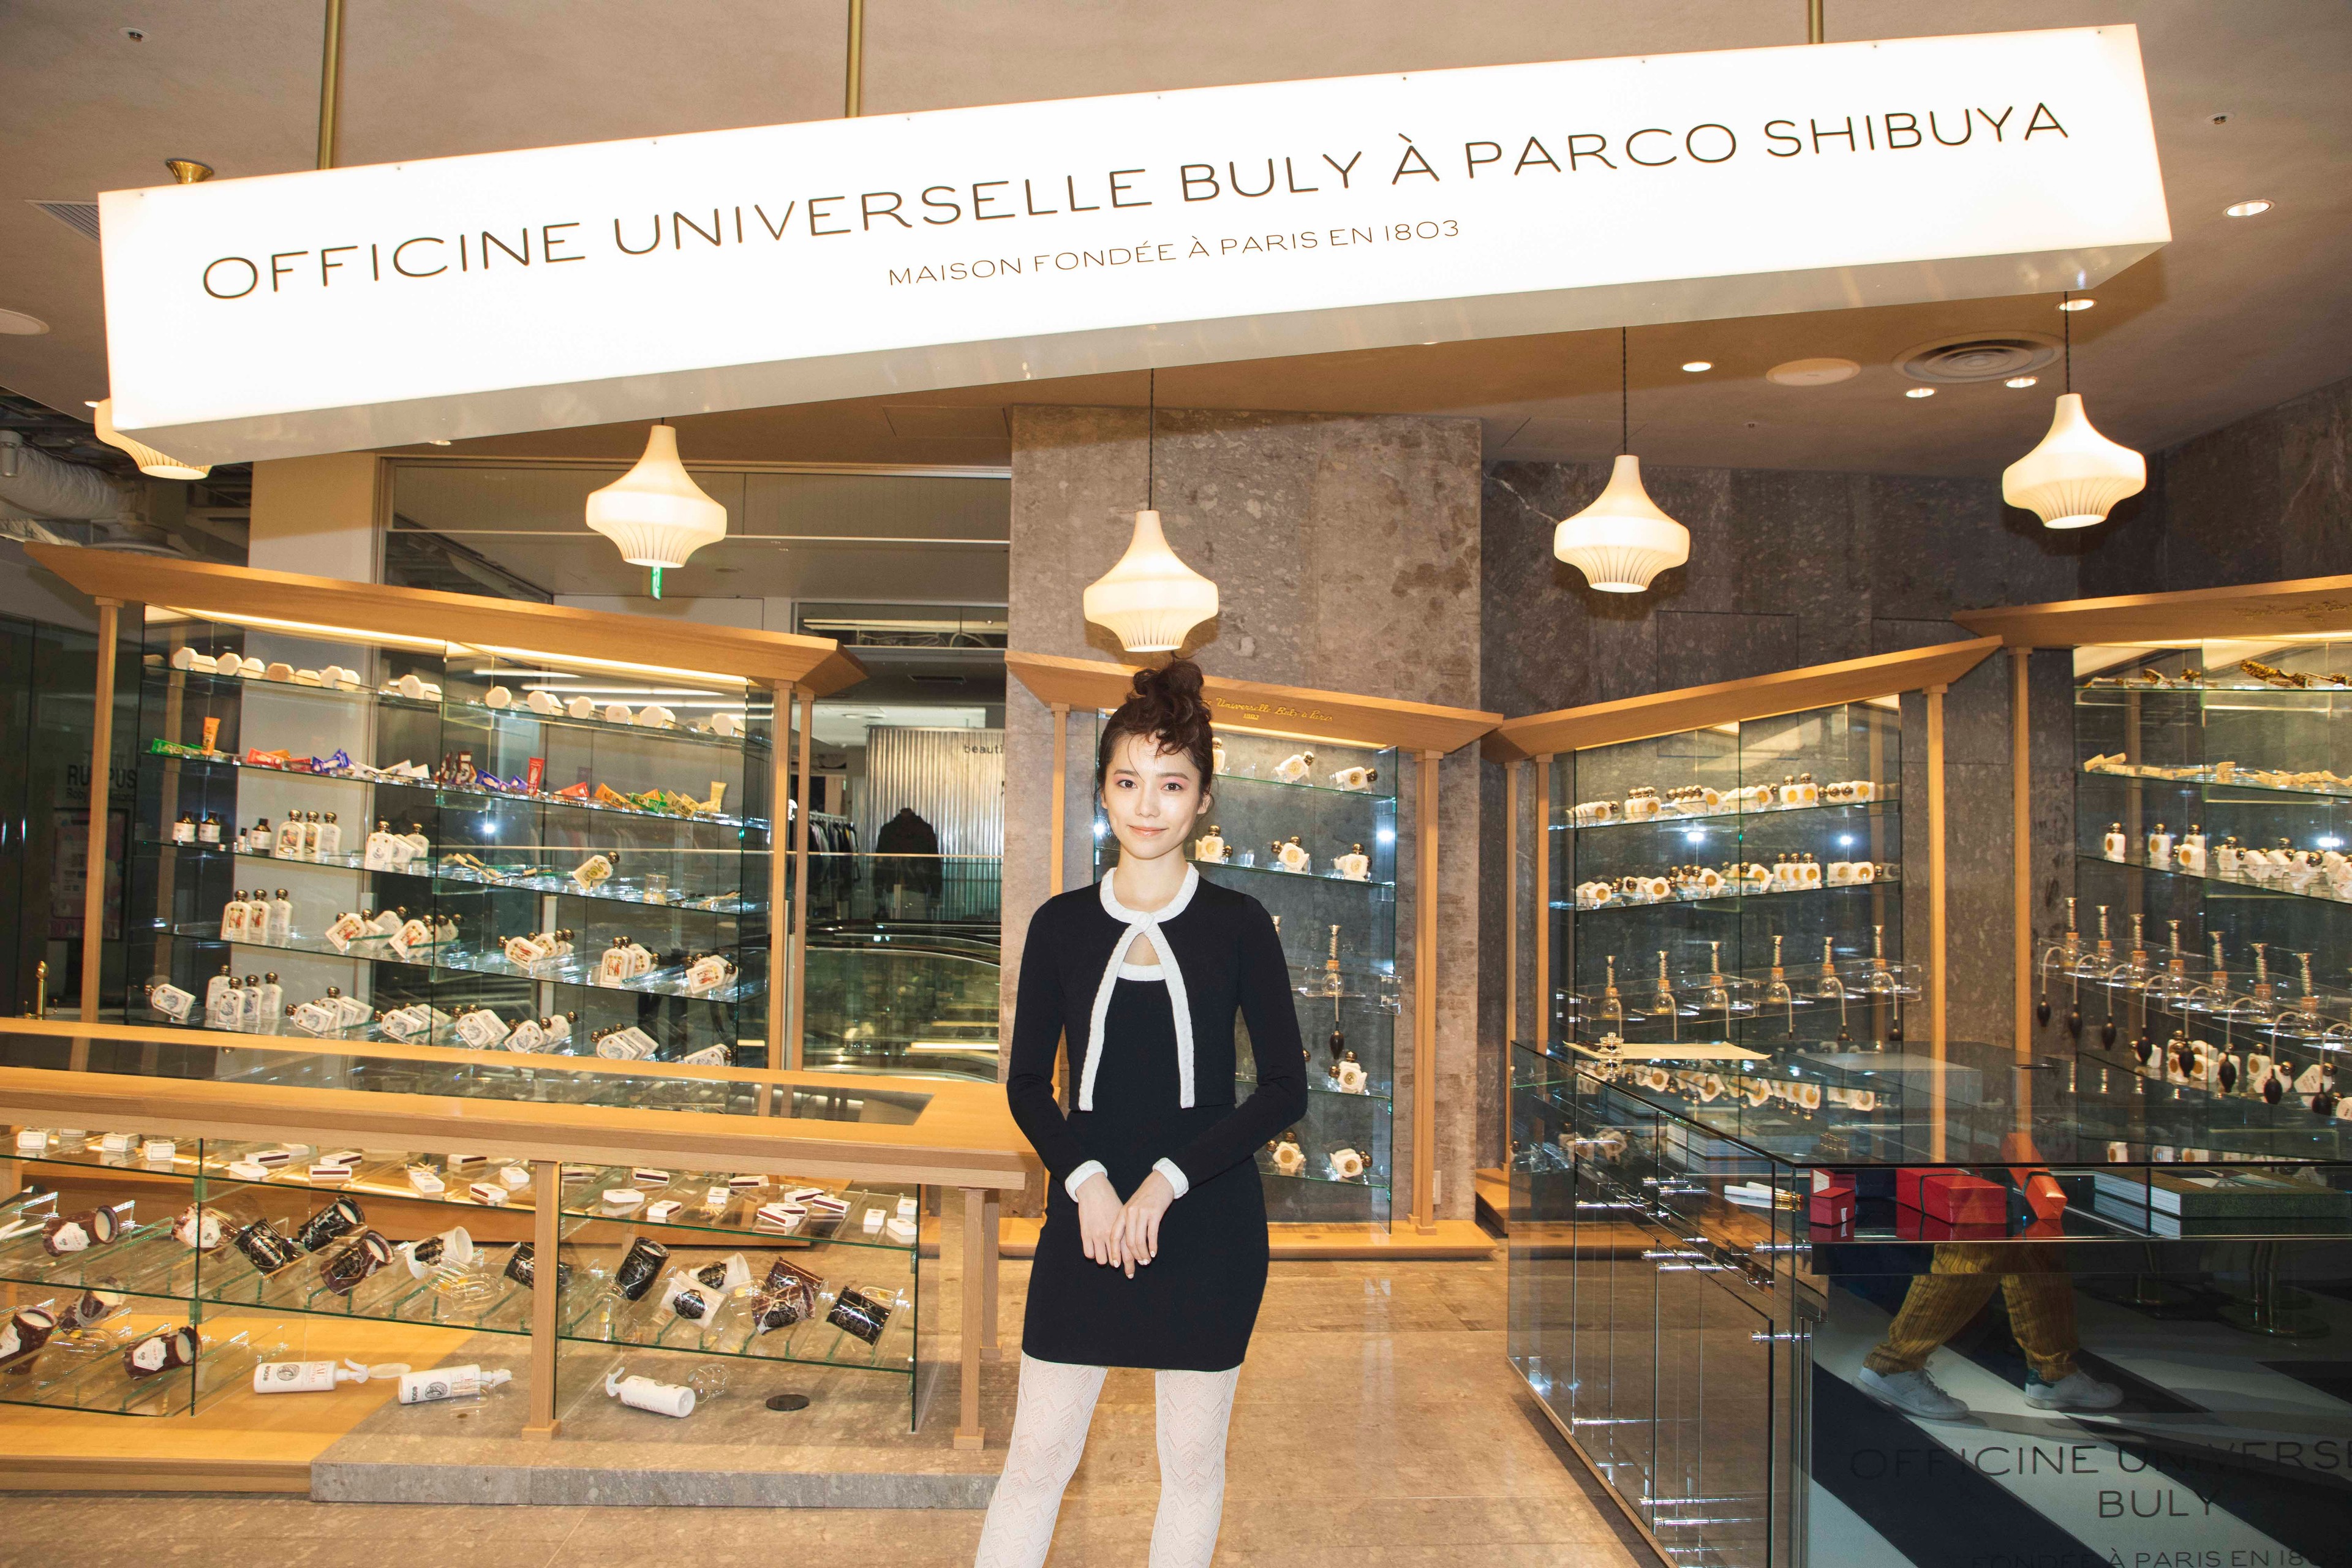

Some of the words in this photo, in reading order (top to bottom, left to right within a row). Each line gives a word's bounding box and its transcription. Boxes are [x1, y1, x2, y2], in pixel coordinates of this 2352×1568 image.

[203, 222, 586, 300] OFFICINE
[614, 168, 1153, 255] UNIVERSELLE
[1180, 151, 1362, 202] BULY
[1392, 132, 1440, 186] À
[1464, 123, 1737, 179] PARCO
[1764, 102, 2068, 157] SHIBUYA
[889, 257, 1021, 286] MAISON
[1034, 240, 1177, 272] FONDÉE
[1188, 235, 1210, 258] À
[1221, 231, 1318, 255] PARIS
[1330, 227, 1373, 246] EN
[1385, 220, 1458, 241] 1803
[67, 764, 137, 789] RUUS
[1850, 1446, 2099, 1480] OFFICINE
[2117, 1440, 2352, 1475] UNIVERS
[2099, 1489, 2220, 1518] BULY
[2135, 1551, 2221, 1568] PARIS
[2231, 1550, 2269, 1567] EN
